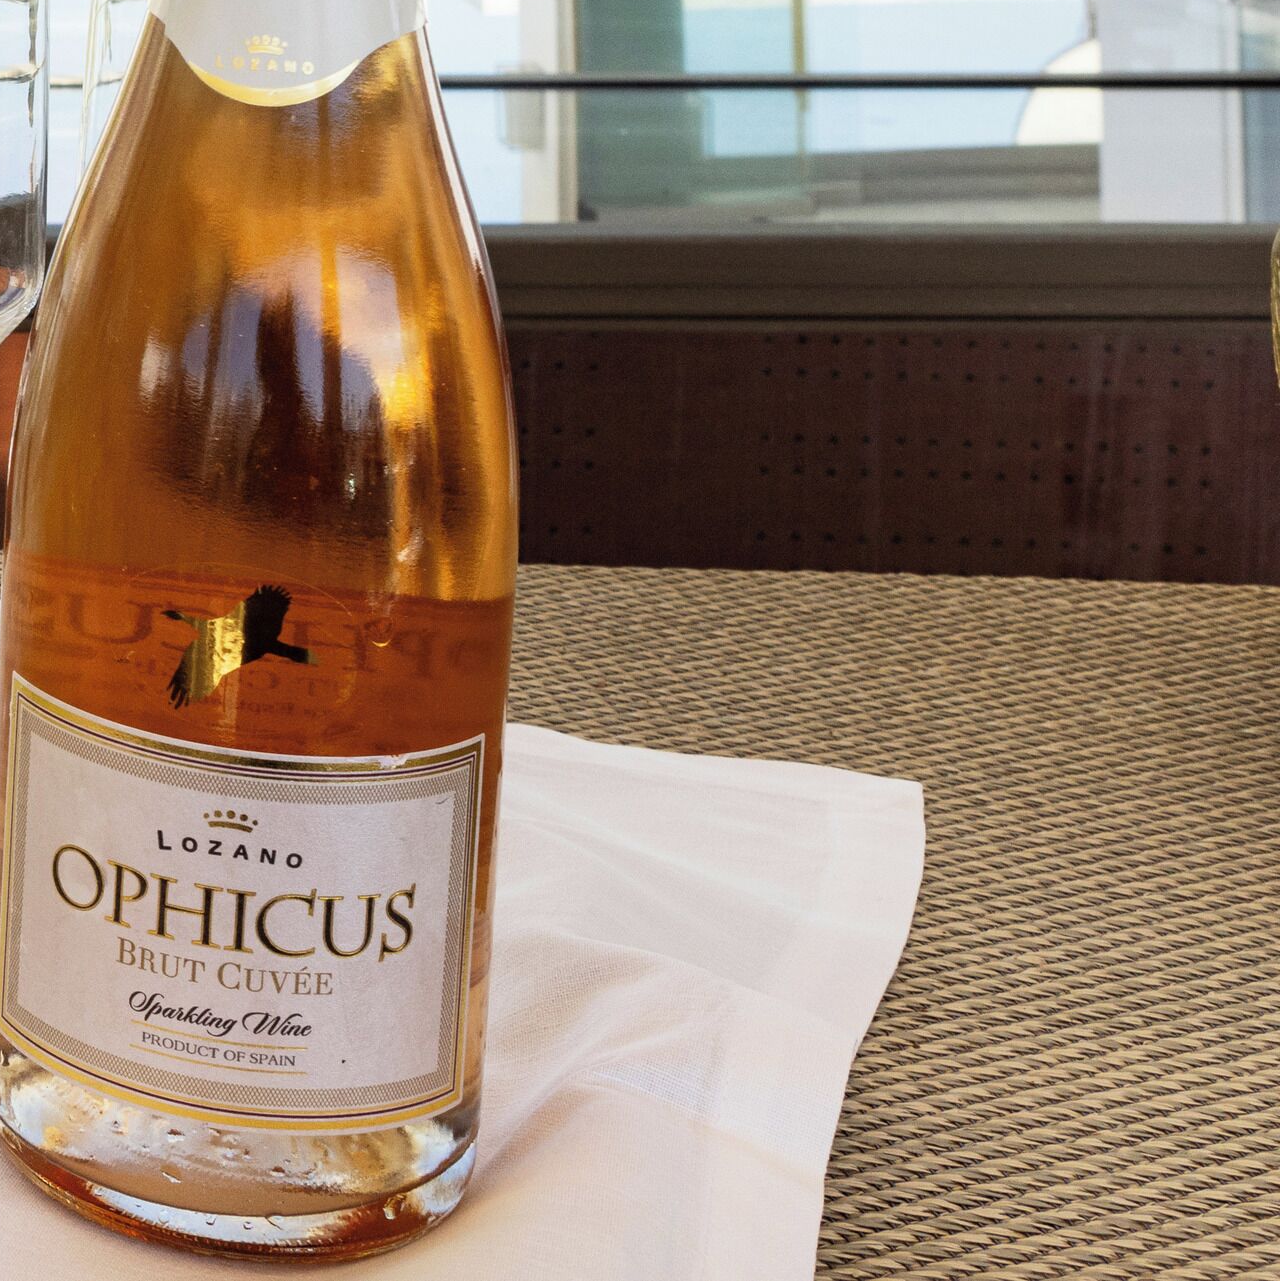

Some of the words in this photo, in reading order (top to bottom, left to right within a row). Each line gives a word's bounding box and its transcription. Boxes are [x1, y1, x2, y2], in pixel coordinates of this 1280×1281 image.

[215, 54, 315, 76] LOZANO
[157, 830, 303, 869] LOZANO
[52, 843, 417, 962] OPHICUS
[116, 936, 206, 984] BRUT
[217, 962, 333, 996] CUVÉE
[129, 990, 236, 1037] Sparkling
[241, 1011, 312, 1037] Wine
[141, 1031, 220, 1060] PRODUCT
[223, 1049, 246, 1064] OF
[249, 1052, 297, 1067] SPAIN
